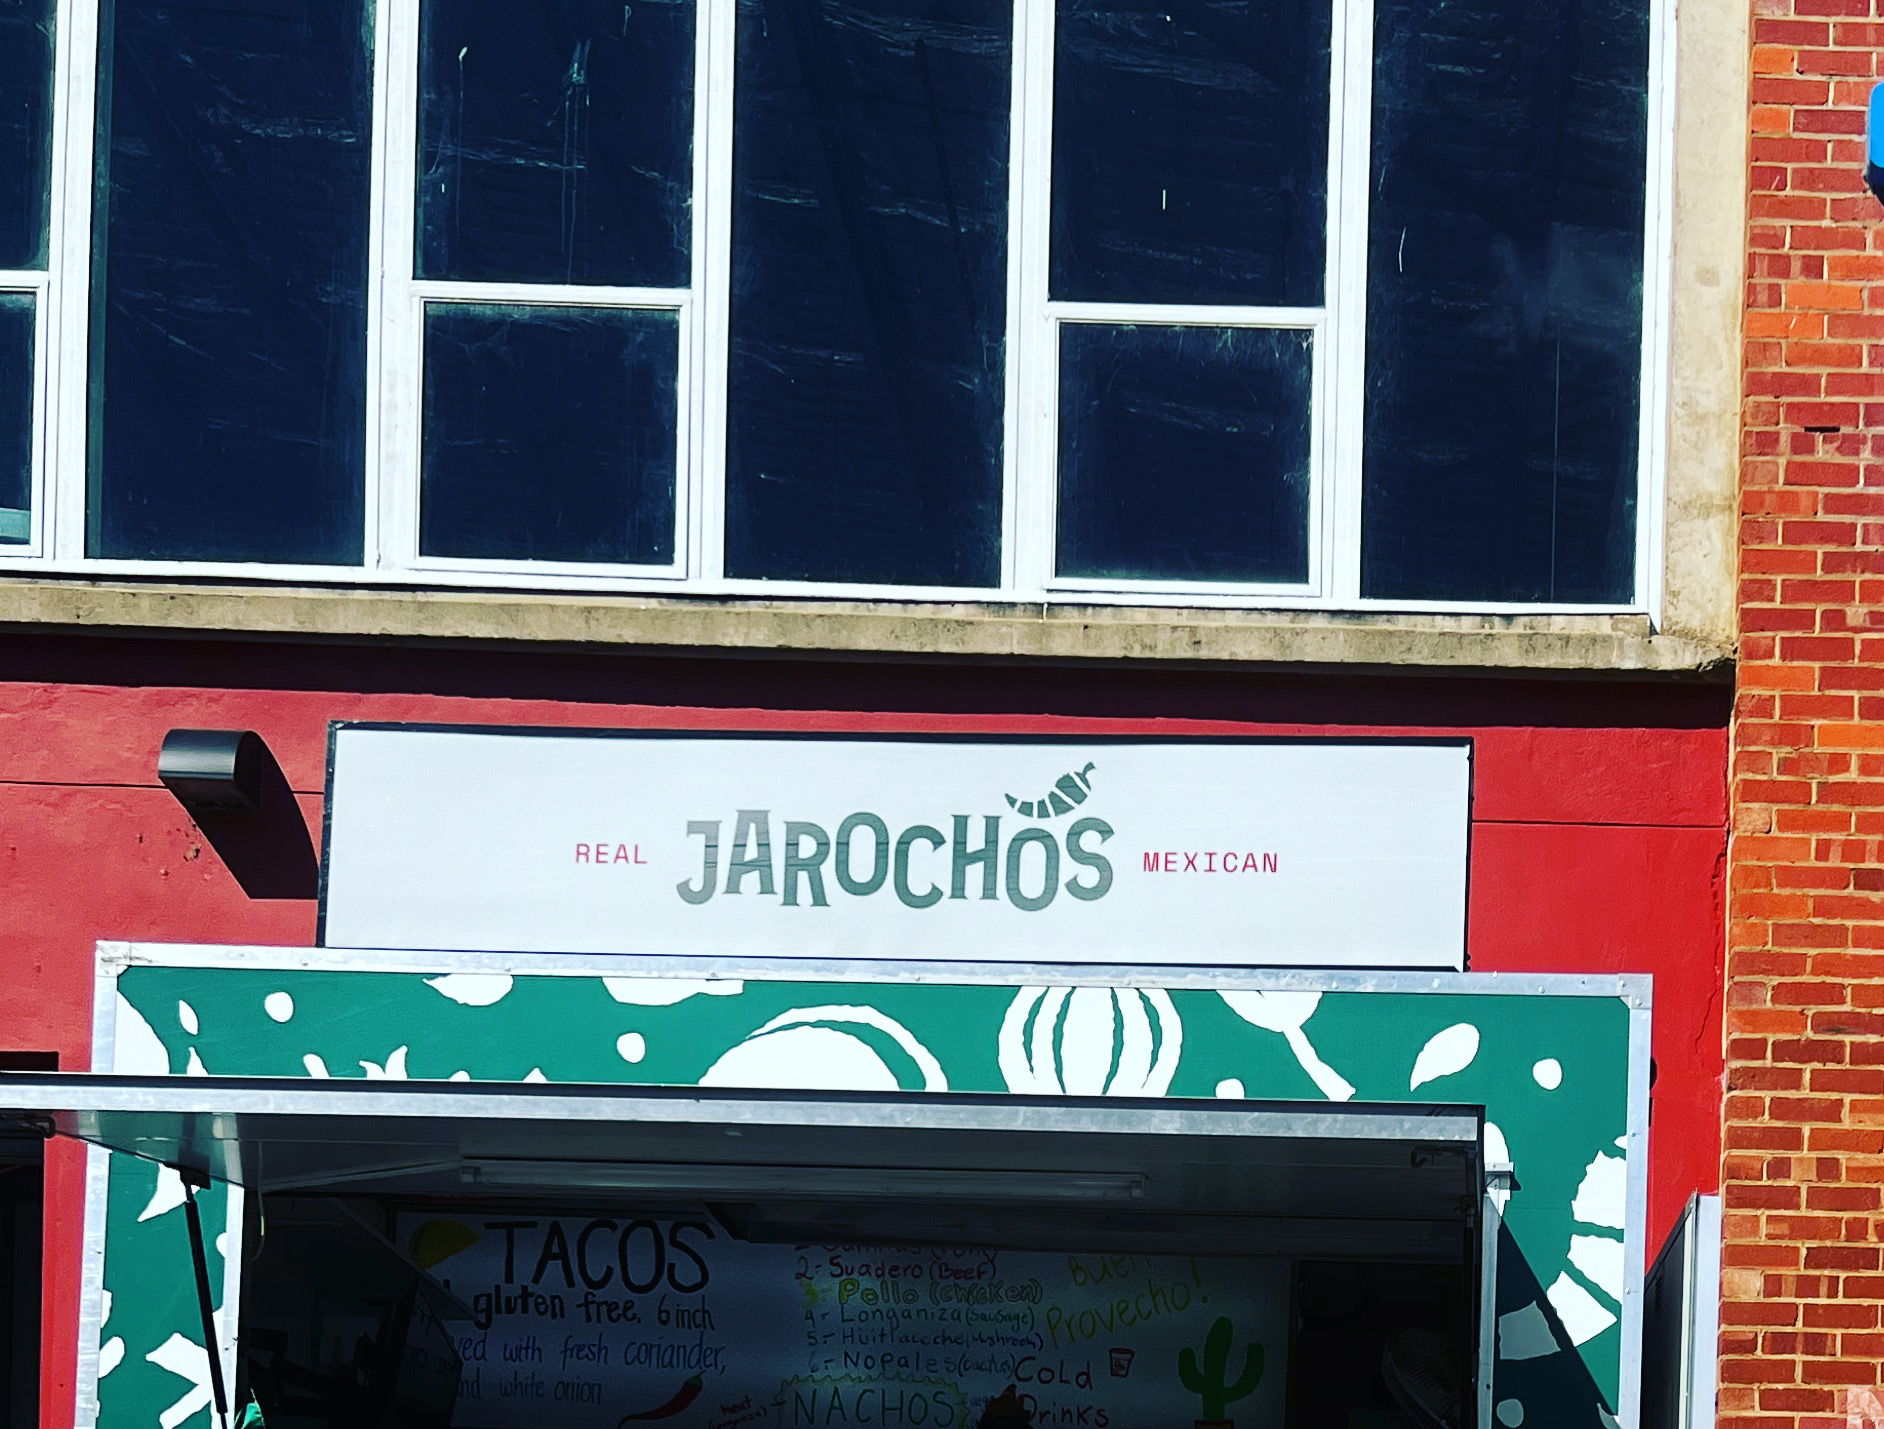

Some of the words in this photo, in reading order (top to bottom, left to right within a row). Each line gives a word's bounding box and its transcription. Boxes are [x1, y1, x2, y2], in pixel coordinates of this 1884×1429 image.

[575, 843, 648, 865] REAL
[676, 809, 1114, 912] JAROCHOS
[1144, 851, 1278, 873] MEXICAN
[483, 1219, 715, 1294] TACOS
[829, 1255, 923, 1278] Suadero
[1068, 1255, 1152, 1287] Bue
[473, 1284, 565, 1330] gluten
[839, 1278, 919, 1306] Pollo
[841, 1306, 961, 1331] Longaniza
[502, 1336, 543, 1363] with
[560, 1333, 608, 1370] fresh
[623, 1332, 727, 1376] coriander,
[499, 1371, 545, 1398] white
[554, 1380, 602, 1406] onion
[794, 1386, 955, 1427] NACHOS
